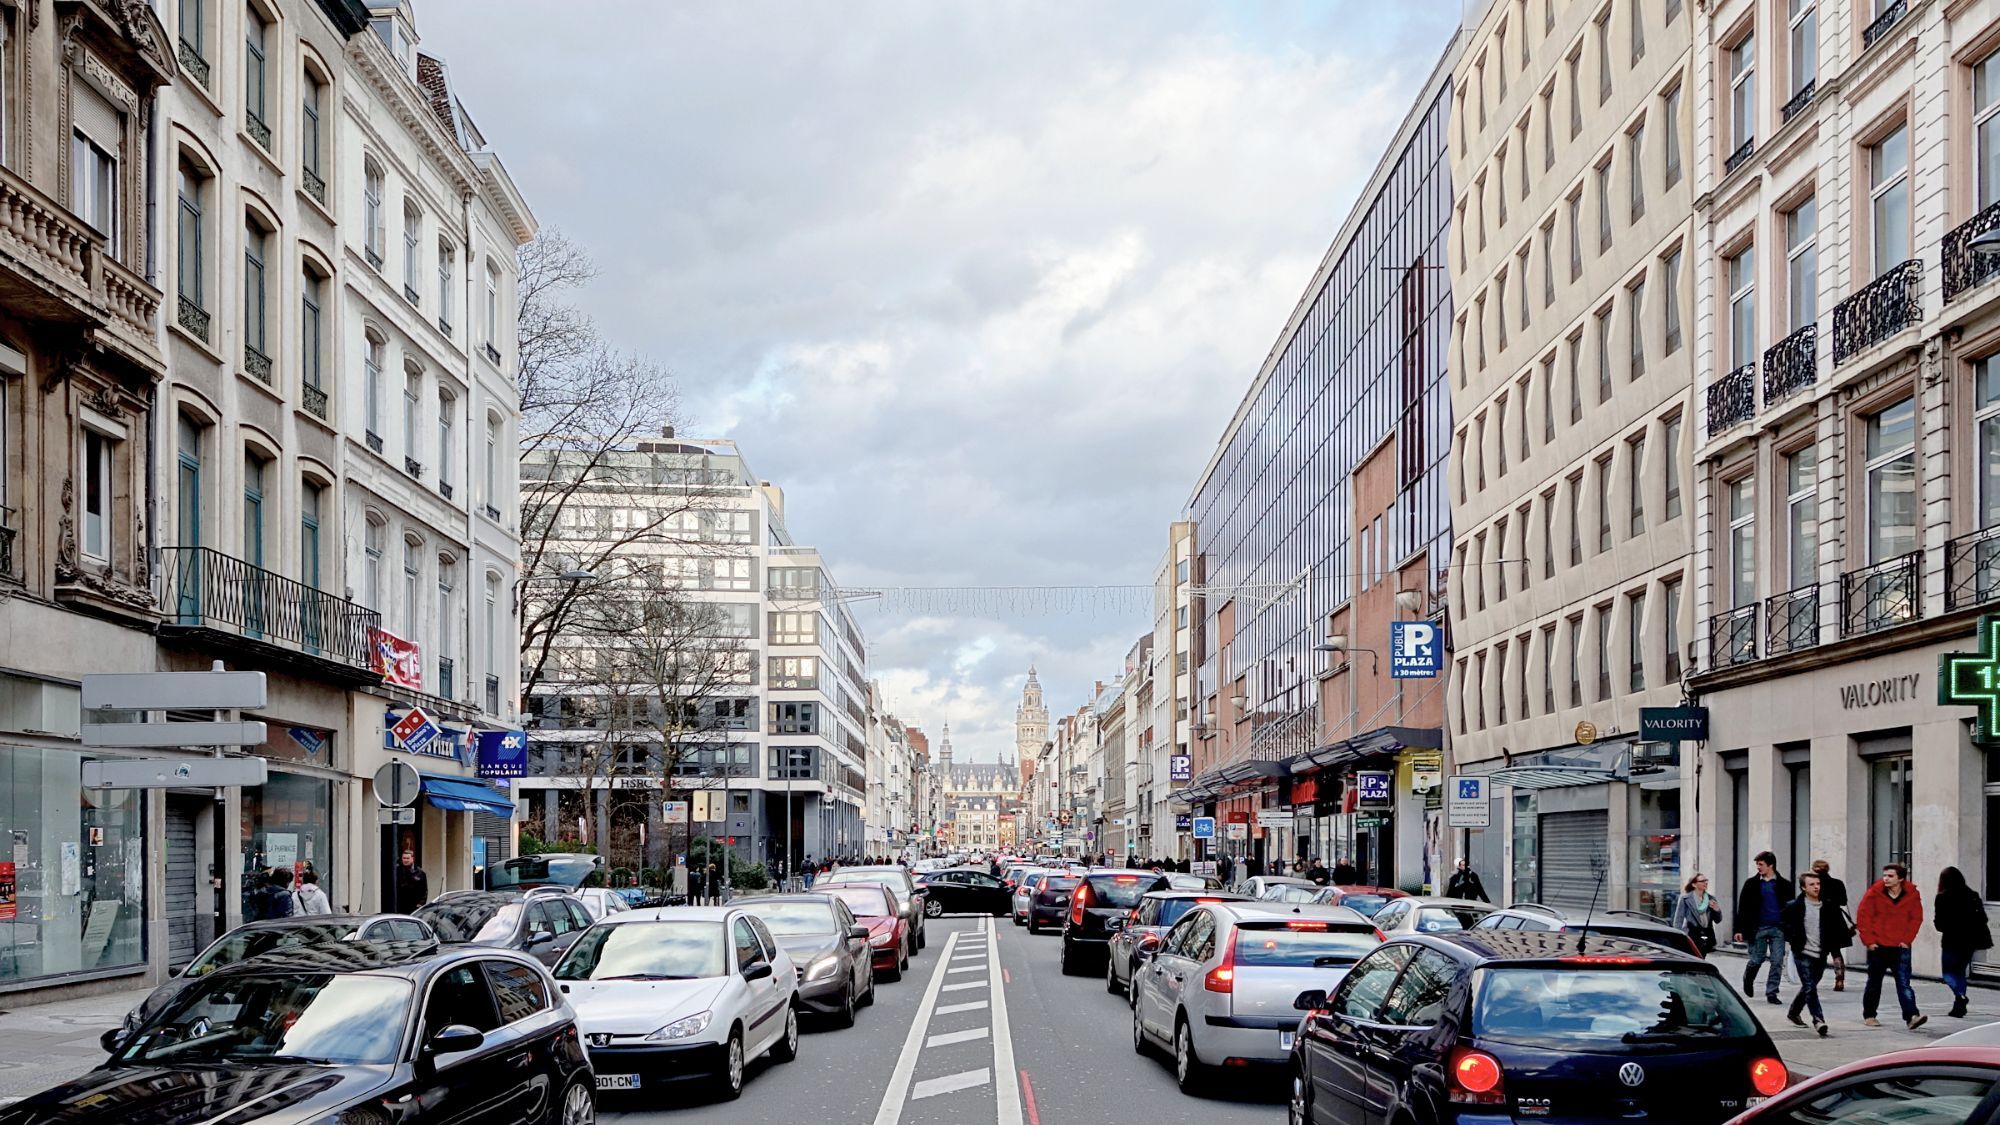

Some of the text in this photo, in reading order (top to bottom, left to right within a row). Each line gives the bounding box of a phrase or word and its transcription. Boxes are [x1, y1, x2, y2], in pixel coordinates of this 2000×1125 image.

[1394, 624, 1403, 657] PUBLIC
[1404, 624, 1434, 657] P
[1394, 657, 1434, 666] PLAZA
[1840, 673, 1920, 710] VALORITY
[1644, 718, 1703, 729] VALORITY
[406, 724, 431, 746] Domino's
[411, 737, 427, 751] Pizza
[433, 735, 454, 757] Pizza
[1177, 756, 1190, 772] P
[1368, 778, 1376, 787] P
[1360, 790, 1388, 798] PLAZA
[678, 856, 685, 864] P
